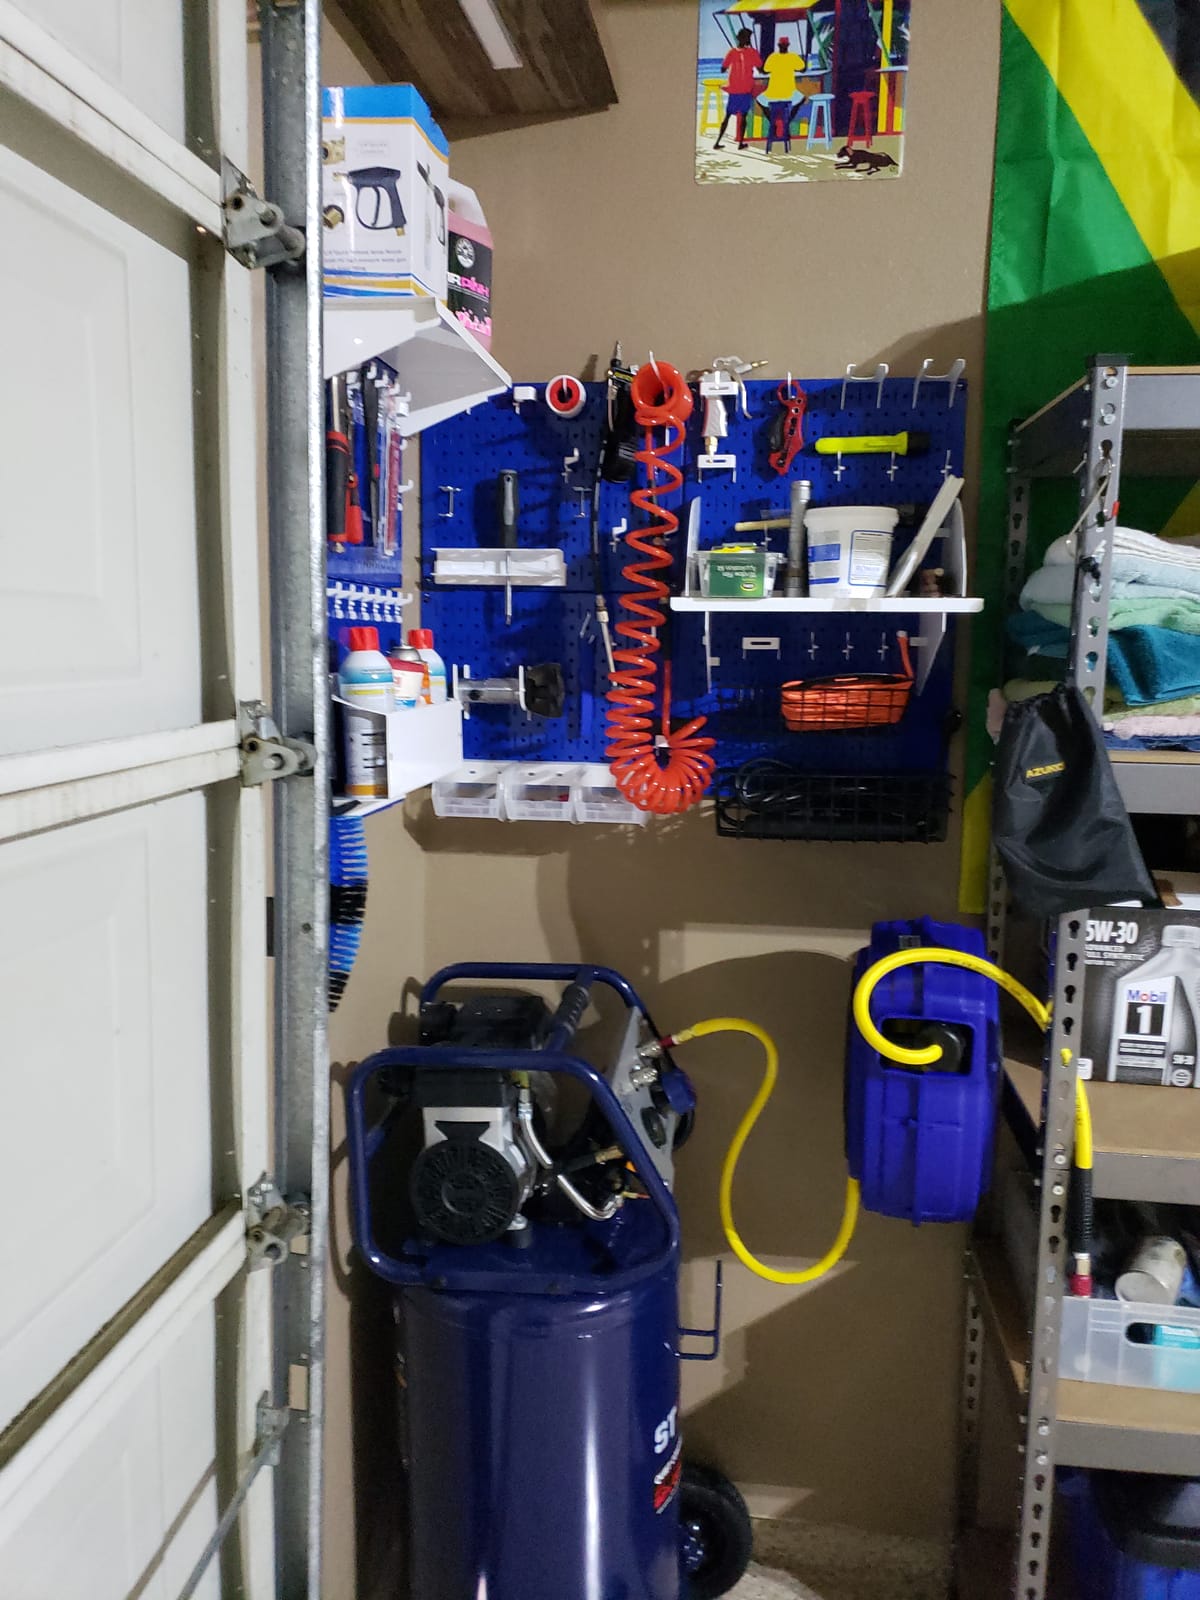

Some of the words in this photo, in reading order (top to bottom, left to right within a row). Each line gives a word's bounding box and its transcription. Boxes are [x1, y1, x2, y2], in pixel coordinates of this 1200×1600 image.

[1085, 919, 1138, 945] 5W-30
[1127, 989, 1167, 1003] Mobil
[1136, 1005, 1152, 1034] 1
